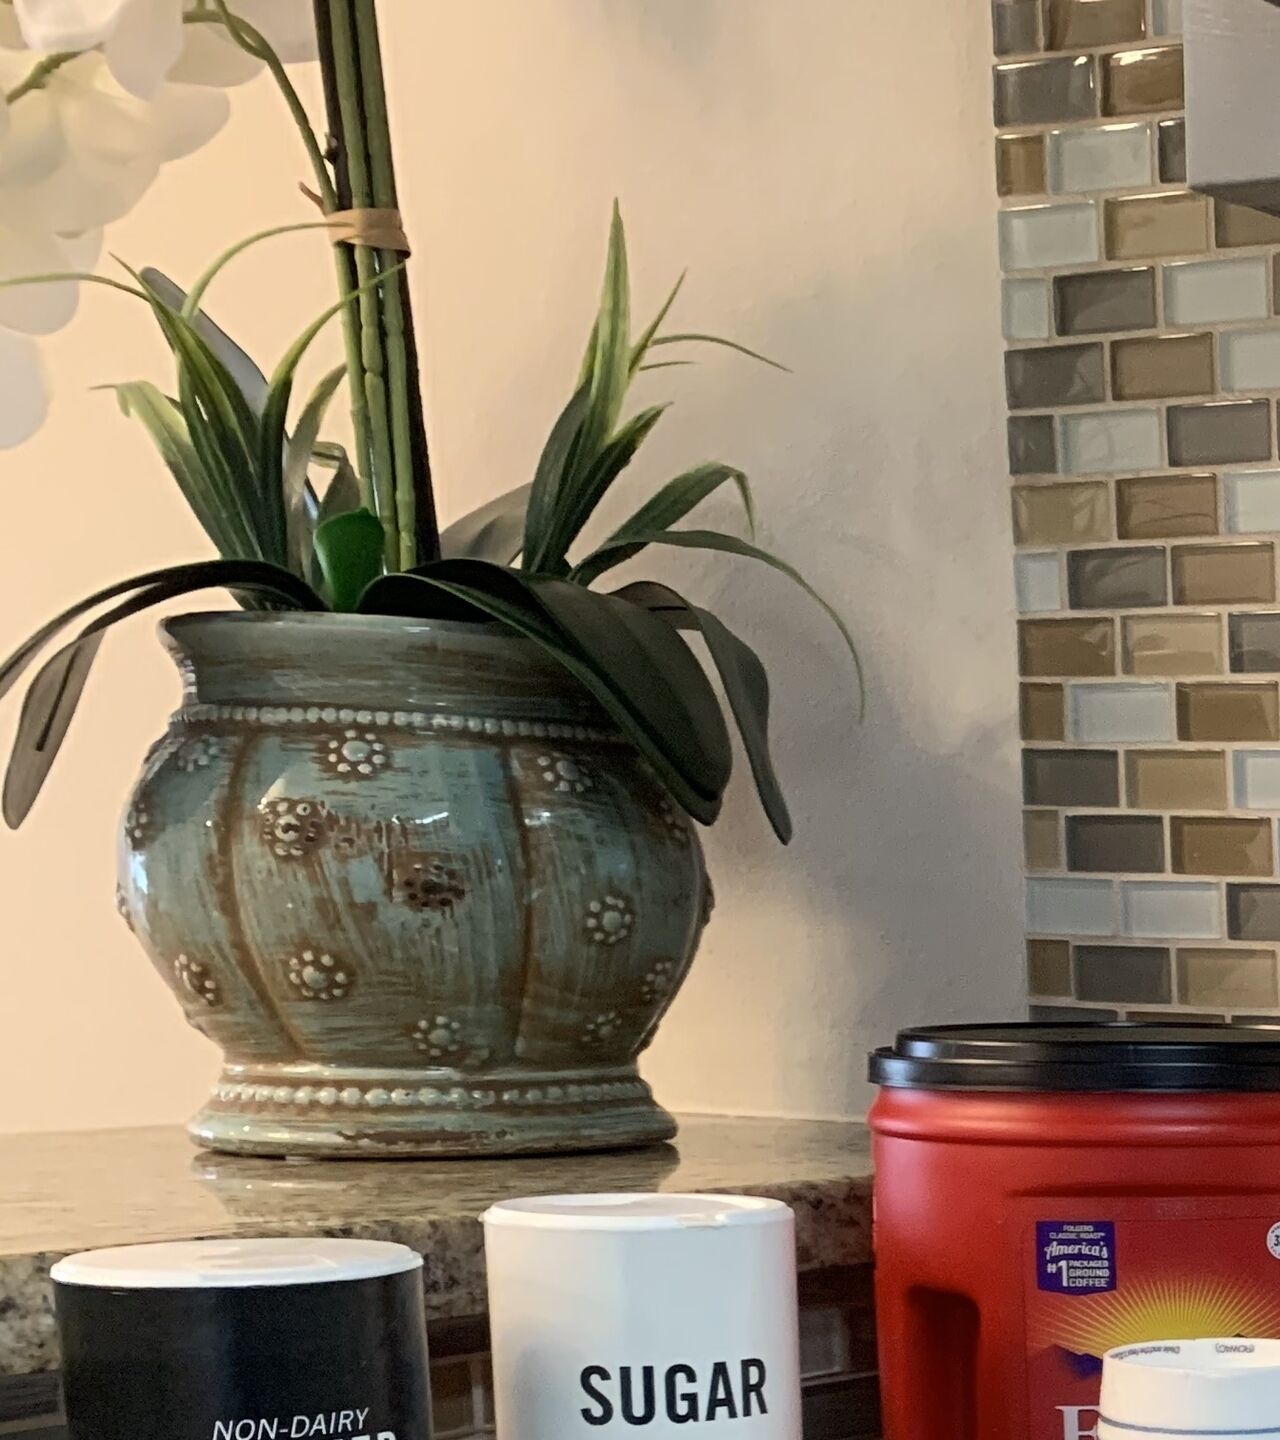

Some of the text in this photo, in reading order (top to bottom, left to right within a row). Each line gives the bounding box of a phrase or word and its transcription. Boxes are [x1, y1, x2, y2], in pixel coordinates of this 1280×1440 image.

[1044, 1241, 1108, 1260] America's
[1047, 1260, 1068, 1287] #1
[1069, 1268, 1110, 1277] GROUND
[1069, 1278, 1109, 1287] COFFEE
[580, 1358, 768, 1426] SUGAR
